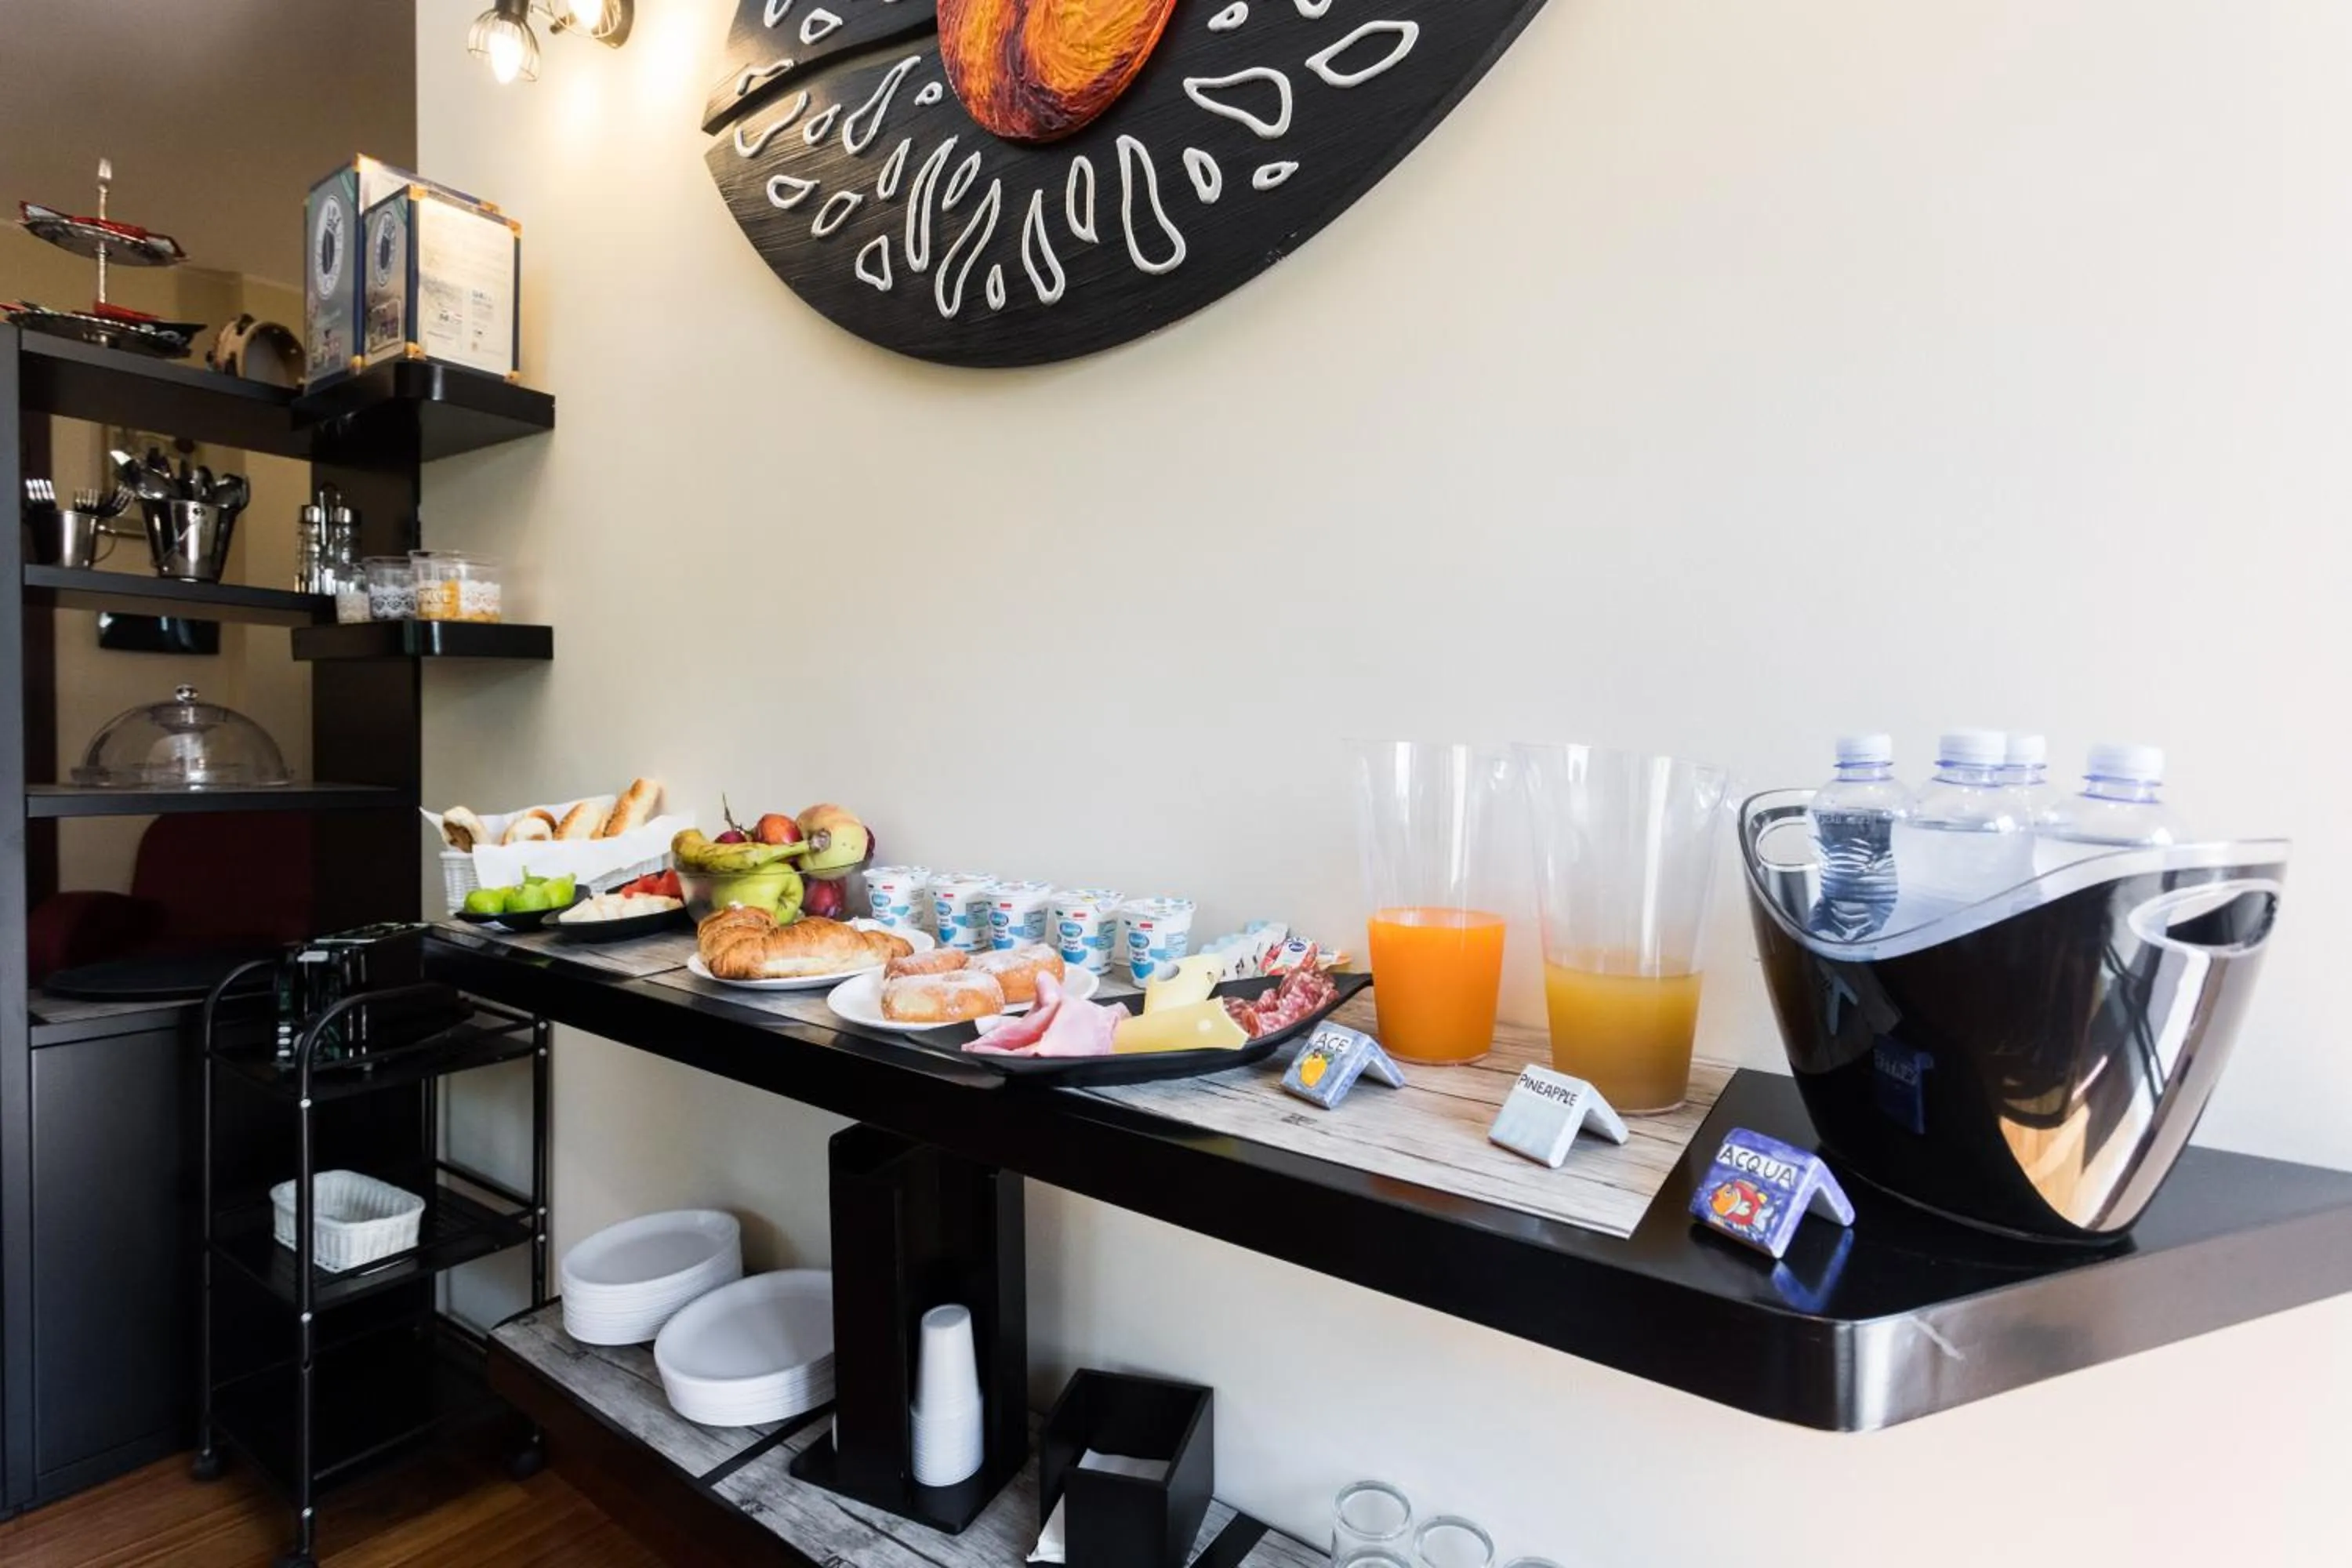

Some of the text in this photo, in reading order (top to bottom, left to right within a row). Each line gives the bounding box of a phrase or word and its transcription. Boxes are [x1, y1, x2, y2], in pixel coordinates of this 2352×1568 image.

[1316, 1033, 1349, 1053] ACE
[1517, 1073, 1579, 1106] PINEAPPLE
[1719, 1145, 1793, 1188] ACQUA
